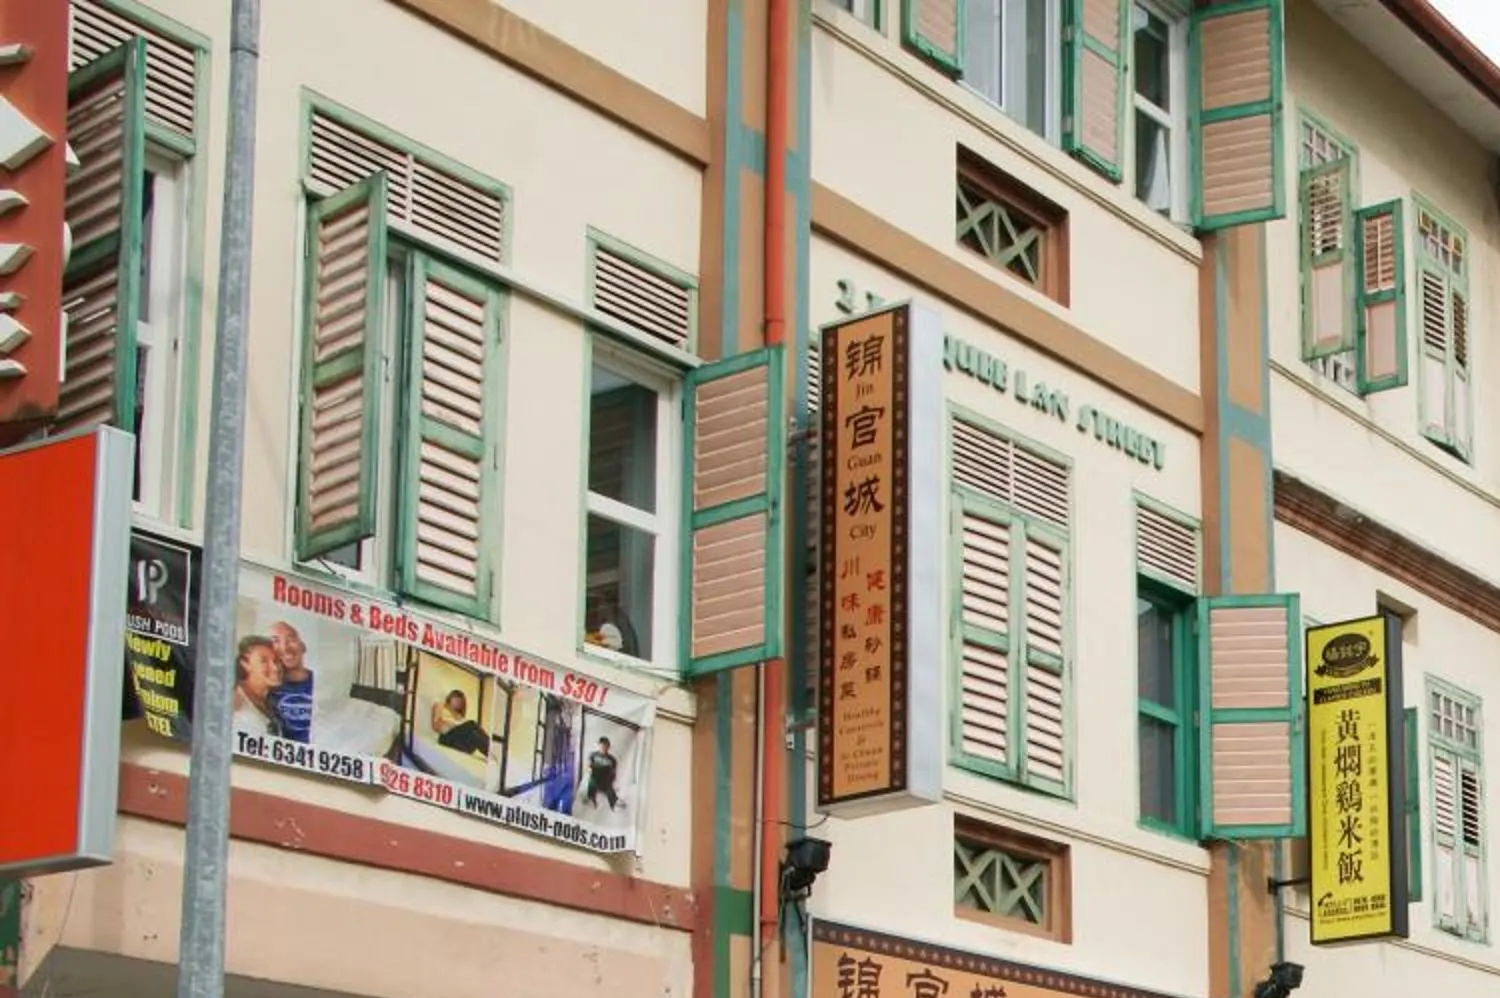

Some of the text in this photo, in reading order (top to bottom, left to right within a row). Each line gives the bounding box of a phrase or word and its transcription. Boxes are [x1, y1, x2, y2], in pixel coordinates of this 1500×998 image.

[944, 334, 1166, 470] UEE LAN STREET
[847, 452, 882, 471] Guan
[849, 522, 877, 541] City
[273, 576, 346, 622] Rooms
[350, 604, 365, 627] &
[369, 605, 417, 642] Beds
[422, 622, 509, 674] Available
[513, 655, 555, 690] from
[134, 664, 176, 687] ened
[237, 731, 269, 761] Tel:
[272, 743, 316, 771] 6341
[318, 750, 364, 780] 9258
[465, 792, 626, 851] www.plush-pods.com
